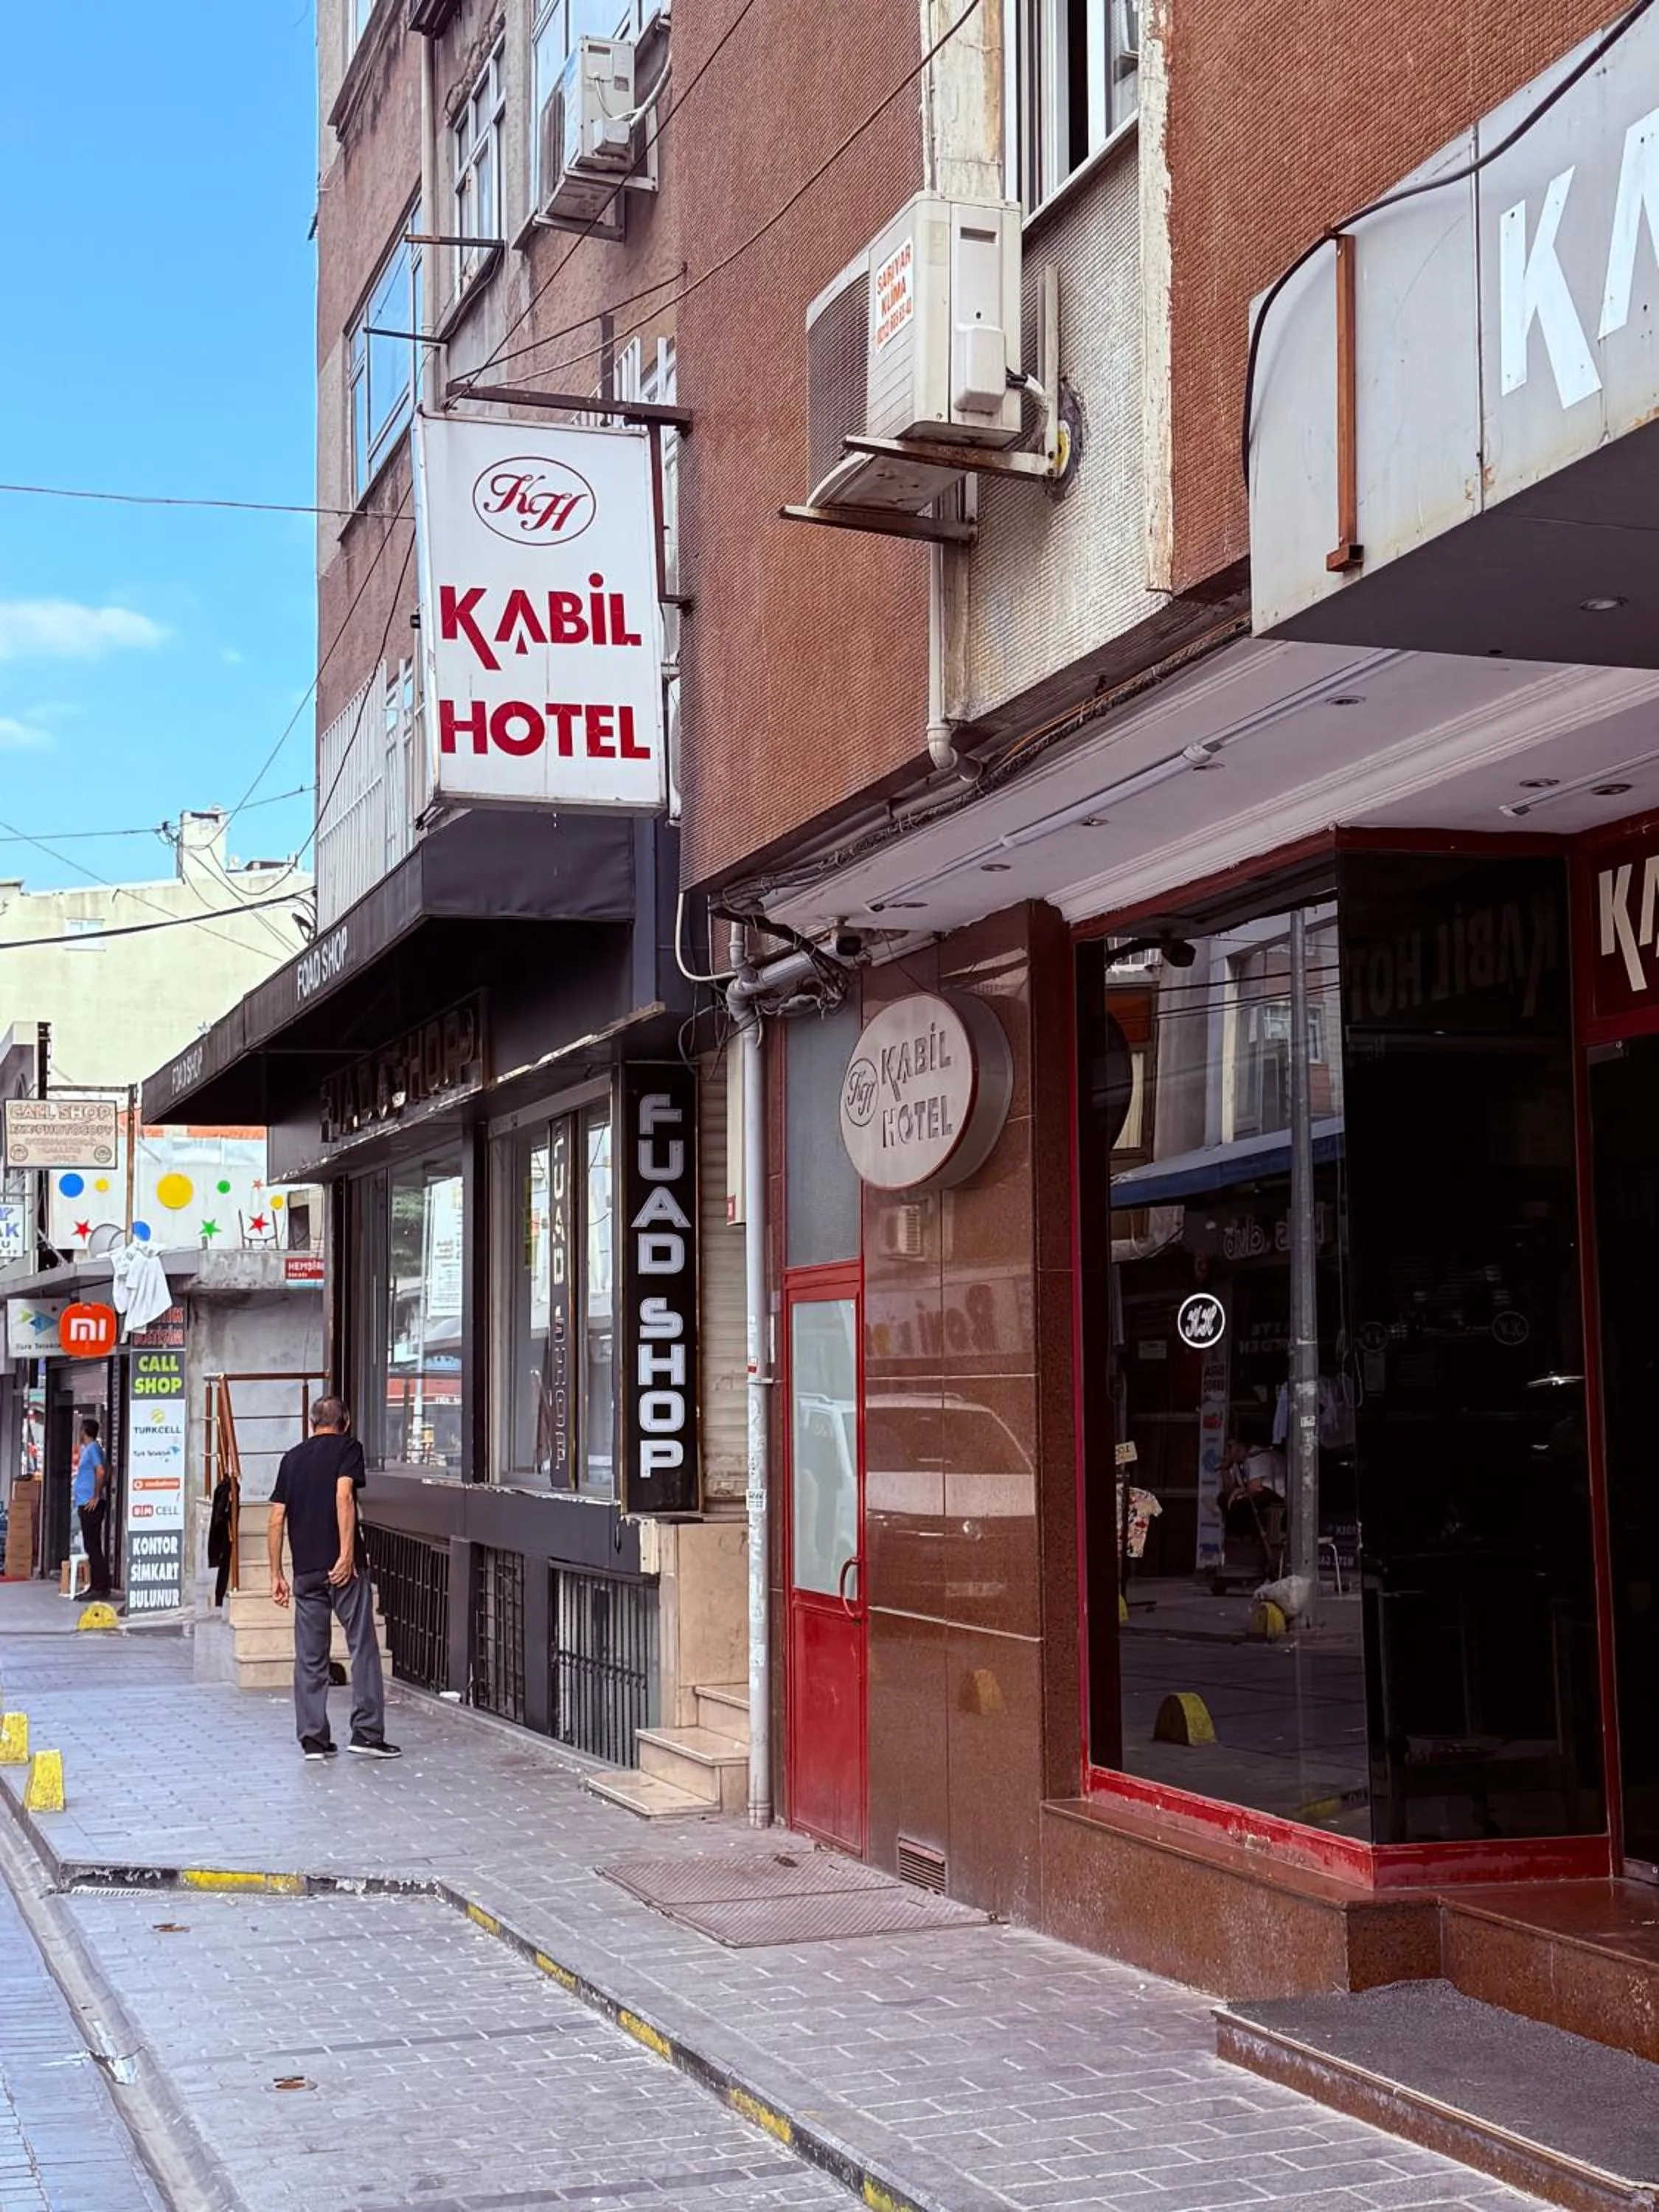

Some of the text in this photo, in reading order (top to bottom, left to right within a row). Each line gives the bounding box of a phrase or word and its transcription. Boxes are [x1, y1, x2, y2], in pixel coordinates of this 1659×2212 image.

[439, 572, 642, 672] KABİL
[438, 700, 651, 759] HOTEL
[321, 926, 348, 981] SHOP
[881, 1021, 952, 1102] KABİL
[58, 1105, 111, 1120] SHOP
[883, 1095, 953, 1148] HOTEL
[631, 1093, 691, 1478] FUAD SHOP
[139, 1355, 179, 1372] CALL
[134, 1377, 182, 1394] SHOP
[133, 1426, 181, 1434] TURKCELL
[156, 1506, 179, 1515] CELL
[133, 1536, 178, 1555] KONTOR
[131, 1559, 179, 1582] SİMKART
[129, 1589, 179, 1608] BULUNUR
